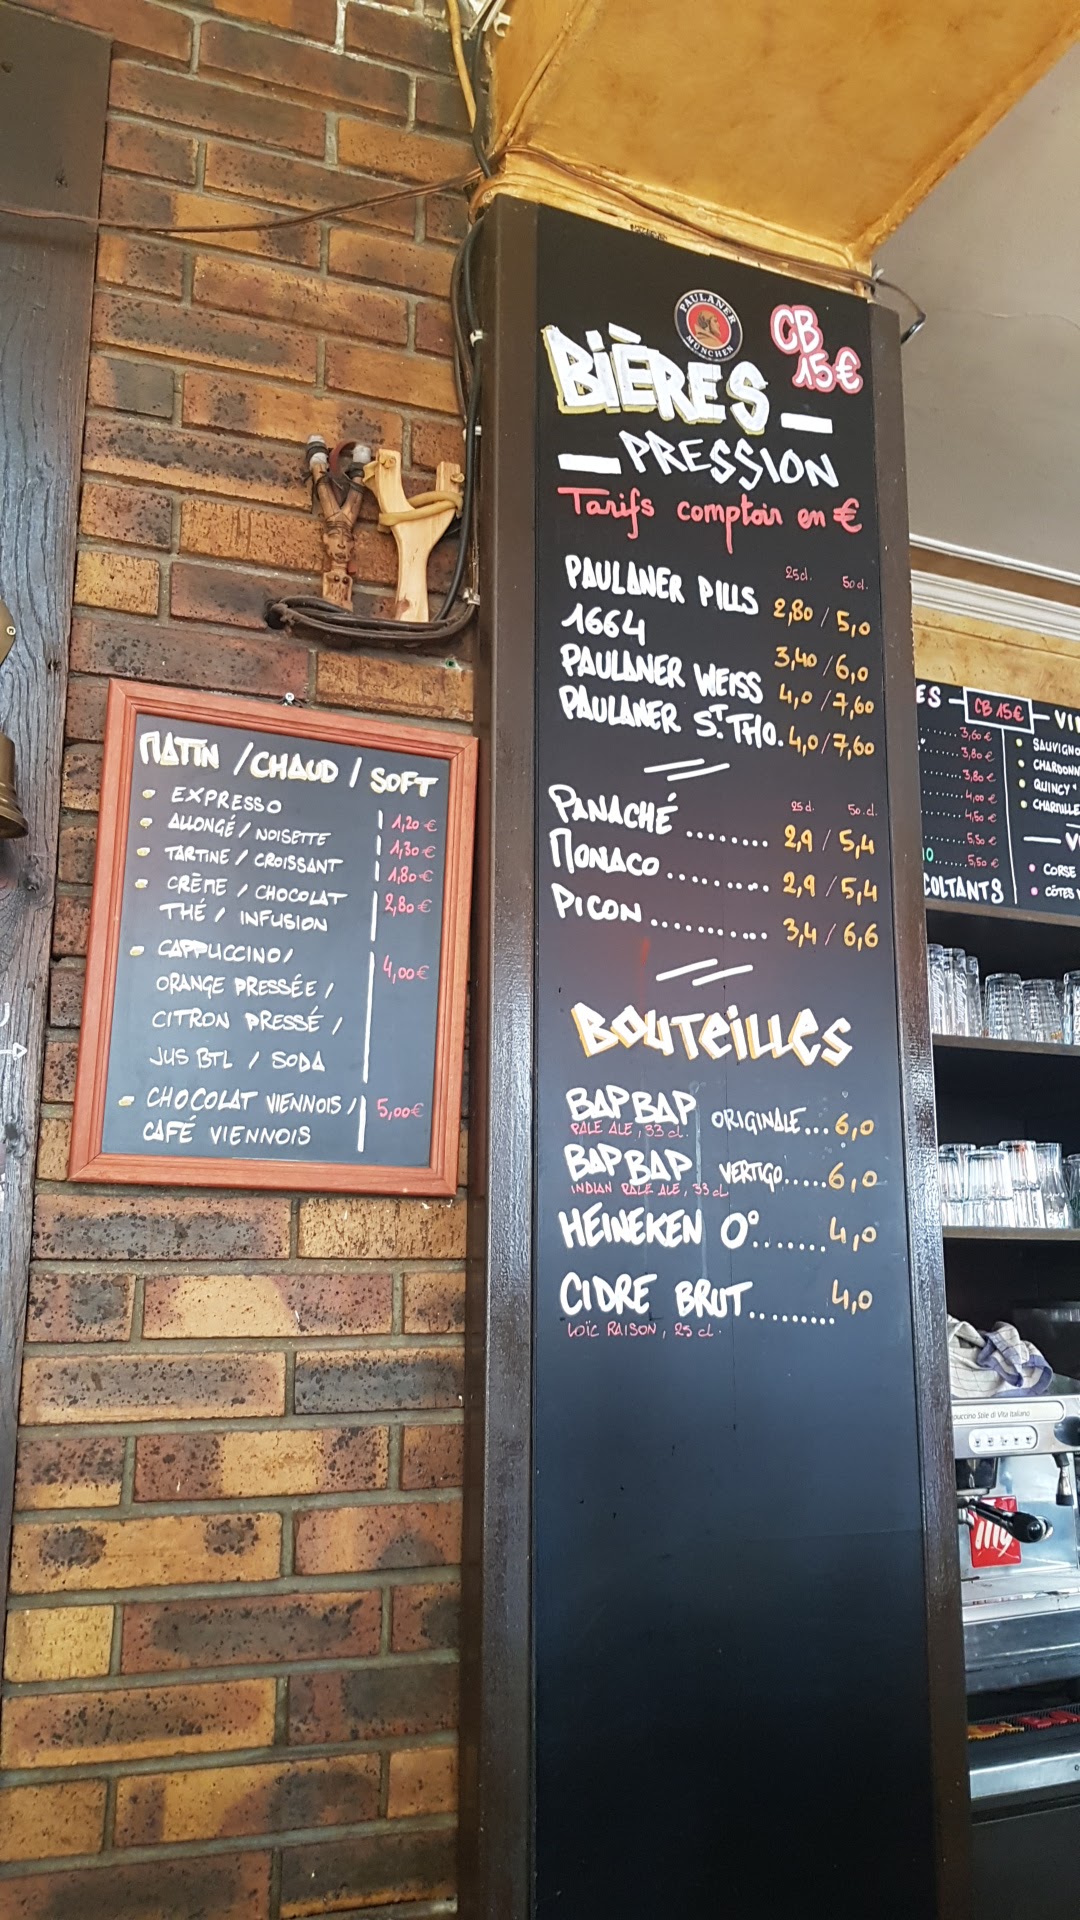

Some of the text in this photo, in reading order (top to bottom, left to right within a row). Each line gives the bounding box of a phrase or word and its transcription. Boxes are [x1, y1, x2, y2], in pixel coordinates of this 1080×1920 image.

[679, 292, 737, 325] PAULANER
[771, 305, 823, 354] CB
[792, 347, 863, 393] 15€
[618, 430, 839, 490] PRESSION
[557, 487, 654, 539] Tarifs
[677, 494, 783, 554] comptoir
[797, 508, 826, 529] en
[565, 555, 685, 603] PAULANER
[698, 575, 759, 615] PILLS
[773, 597, 814, 627] 2,80
[837, 610, 871, 638] 5,0
[561, 603, 646, 647] 1664
[774, 645, 818, 672] 3,40
[836, 653, 869, 686] 6,0
[560, 643, 686, 689] PAULANER
[693, 663, 763, 704] WEISS
[558, 684, 682, 734] PAULANER
[974, 697, 993, 717] CB
[139, 731, 220, 769] MATIN
[370, 767, 439, 798] SOFT
[171, 786, 282, 814] EXPRESSO
[168, 812, 237, 838] ALLONGÉ
[255, 827, 332, 846] NOISETTE
[548, 784, 678, 835] PANACHÉ
[784, 824, 812, 853] 2,9
[839, 829, 875, 860] 5,4
[165, 844, 231, 865] TARTINE
[254, 852, 345, 874] CROISSANT
[549, 828, 660, 877] MONACO
[783, 870, 815, 898] 2,9
[841, 877, 877, 906] 5,4
[1043, 863, 1077, 879] CORSE
[255, 884, 348, 906] CHOCOLAT
[159, 897, 206, 923] THÉ
[240, 909, 328, 932] INFUSION
[551, 883, 642, 923] PICON
[783, 918, 817, 948] 3,4
[843, 922, 879, 951] 6,6
[156, 974, 226, 1000] ORANGE
[234, 974, 317, 998] PRESSÉE
[152, 1008, 231, 1029] CITRON
[245, 1005, 325, 1033] PRESSÉ
[149, 1046, 189, 1067] JUS
[196, 1046, 233, 1069] BTL
[271, 1050, 326, 1073] SODA
[146, 1086, 259, 1112] CHOCOLAT
[266, 1092, 342, 1115] VIENNOIS
[143, 1115, 312, 1146] CAFÉ VIENNOIS
[571, 1120, 603, 1136] PALE
[645, 1124, 664, 1137] 33
[835, 1113, 875, 1141] 6,0
[571, 1181, 613, 1196] INDIAN
[621, 1182, 654, 1196] PALE
[693, 1183, 710, 1196] 33
[828, 1162, 878, 1193] 6,0
[558, 1202, 703, 1249] HEINEKEN
[829, 1216, 877, 1252] 4,0
[559, 1271, 873, 1319] CIDRE BRUT 4,0
[674, 1322, 693, 1338] 25
